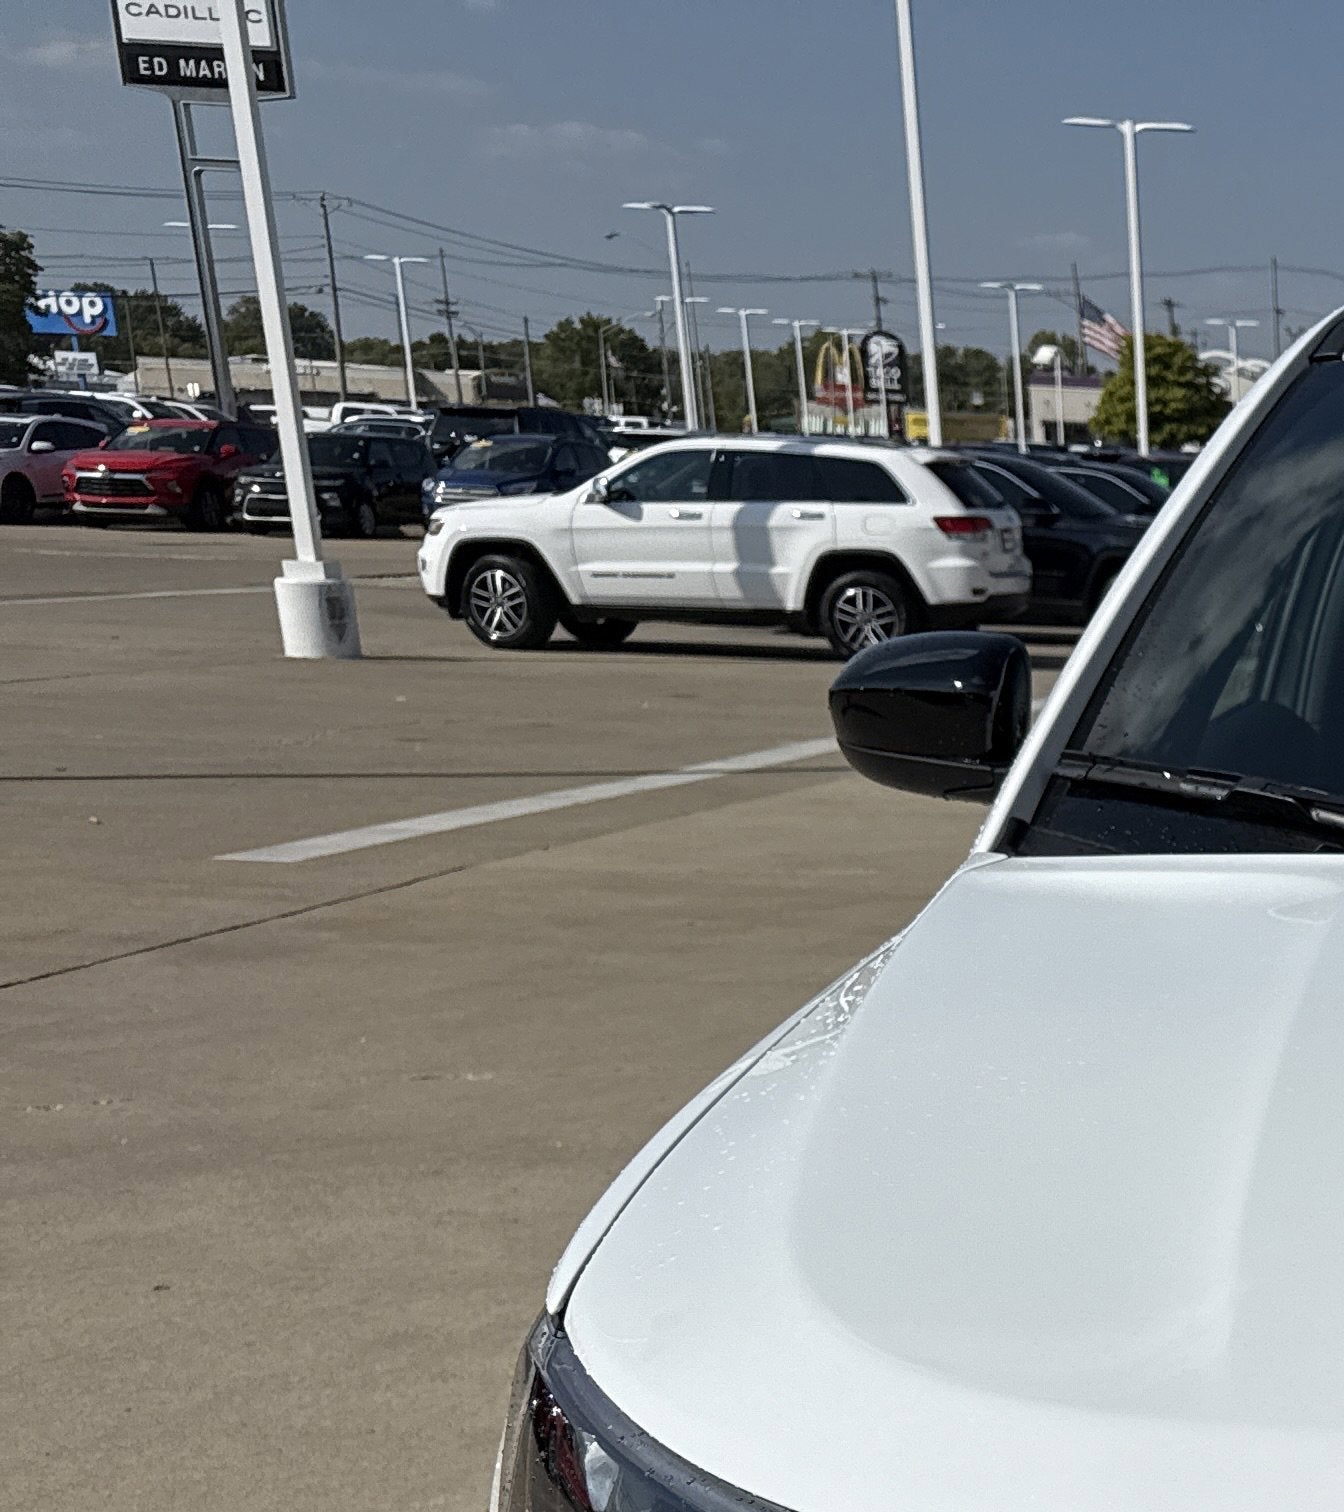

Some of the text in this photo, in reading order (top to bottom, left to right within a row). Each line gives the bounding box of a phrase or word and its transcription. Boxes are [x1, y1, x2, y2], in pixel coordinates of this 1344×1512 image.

[124, 2, 263, 24] CADILLC
[138, 56, 265, 82] ED MARN
